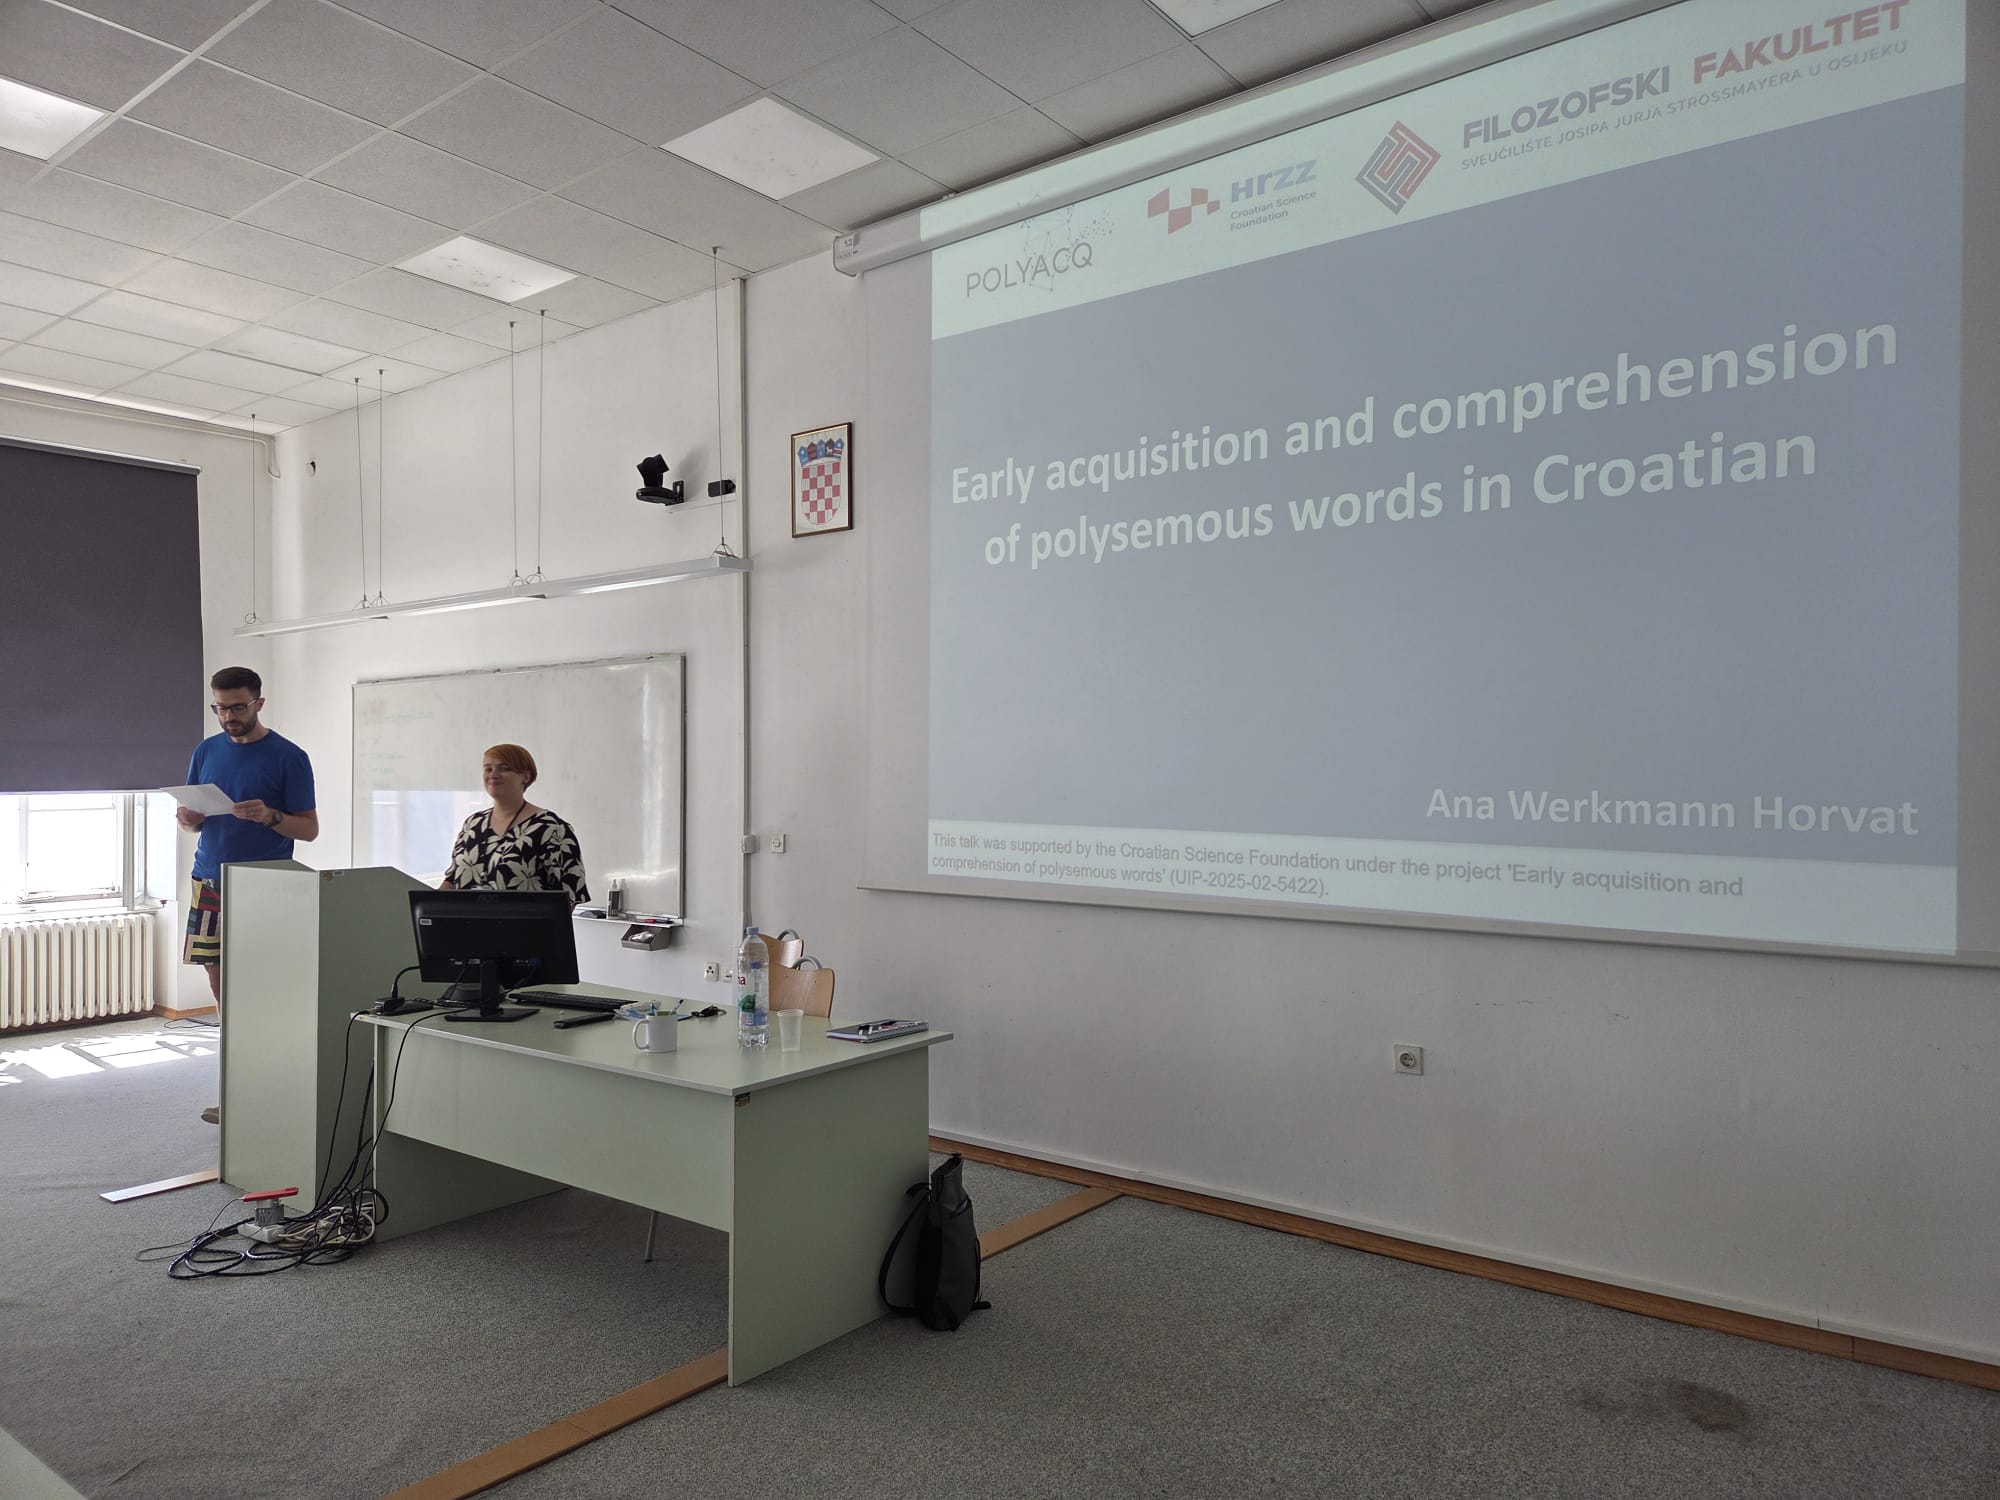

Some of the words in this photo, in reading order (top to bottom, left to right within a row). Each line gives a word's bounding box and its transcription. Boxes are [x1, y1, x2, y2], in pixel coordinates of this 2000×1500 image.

[1463, 65, 1671, 149] FILOZOFSKI
[1693, 0, 1907, 85] FAKULTET
[1461, 135, 1553, 170] SVEUČILIŠTE
[1557, 122, 1609, 146] JOSIPA
[1613, 107, 1663, 129] JURJA
[1667, 69, 1802, 115] STROSSMAYERA
[1808, 65, 1821, 78] U
[1828, 39, 1908, 72] OSIJEKU
[1230, 203, 1274, 220] Croatian
[1276, 191, 1317, 208] Science
[1230, 210, 1289, 232] Foundation
[966, 242, 1093, 298] POLYACQ
[952, 458, 1035, 504] Early
[1046, 425, 1268, 492] acquisition
[1285, 397, 1375, 455] and
[1392, 324, 1897, 439] comprehension
[984, 523, 1021, 566] of
[1031, 503, 1274, 570] polysemous
[1288, 472, 1443, 532] words
[1463, 465, 1512, 513] in
[1532, 432, 1817, 504] Croatian
[1426, 789, 1495, 820] Ana
[1508, 790, 1735, 828] Werkmann
[1753, 795, 1919, 836] Horvat
[932, 855, 1021, 875] comprehension
[1024, 862, 1037, 874] of
[1039, 863, 1117, 881] polysemous
[1170, 870, 1330, 898] (UIP-2025-02-5422).
[933, 833, 956, 848] This
[959, 835, 980, 849] talk
[983, 839, 1006, 851] was
[1010, 839, 1072, 855] supported
[1075, 840, 1092, 858] by
[1095, 841, 1117, 857] the
[1120, 843, 1180, 861] Croatian
[1184, 847, 1244, 865] Science
[1249, 849, 1340, 871] Foundation
[1345, 855, 1396, 874] under
[1401, 858, 1430, 876] the
[1436, 859, 1502, 882] project
[1507, 864, 1565, 888] 'Early
[1571, 869, 1691, 892] acquisition
[1699, 878, 1744, 896] and
